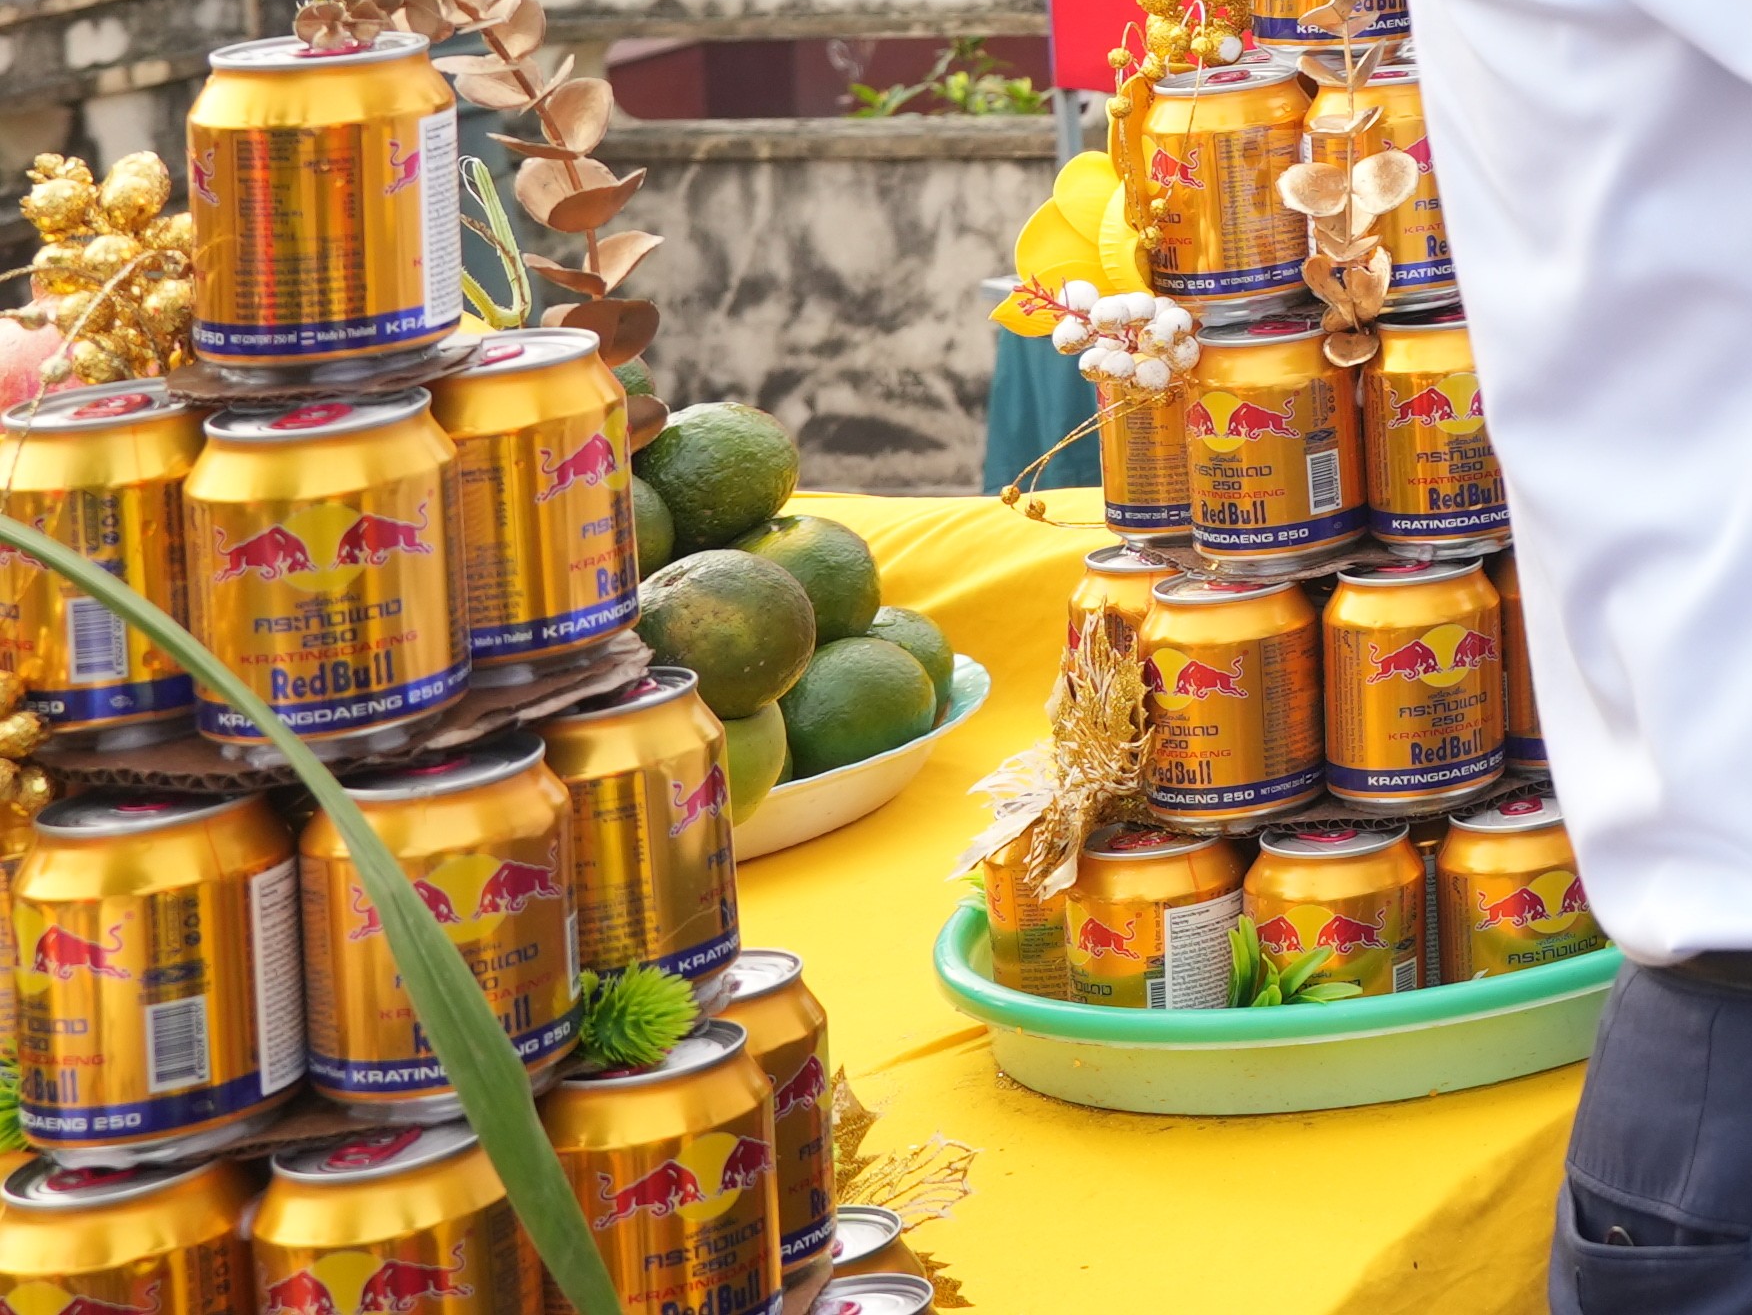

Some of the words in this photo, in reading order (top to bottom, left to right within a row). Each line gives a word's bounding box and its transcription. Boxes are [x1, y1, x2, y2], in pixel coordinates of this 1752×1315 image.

[1187, 279, 1215, 290] 250
[1448, 460, 1484, 475] 250
[1212, 480, 1242, 491] 250
[1391, 511, 1511, 530] KRATINGDAENG
[1278, 527, 1309, 539] 250
[303, 628, 358, 648] 250
[217, 693, 403, 728] KRANGDAENG
[407, 680, 445, 704] 250
[1387, 713, 1495, 742] KRATINGDAENG
[1431, 712, 1466, 728] 250
[1160, 738, 1189, 750] 250
[1367, 758, 1488, 786] KRATINGDAENG
[1223, 789, 1256, 803] 250
[543, 1021, 572, 1048] 250
[93, 1112, 142, 1128] 250
